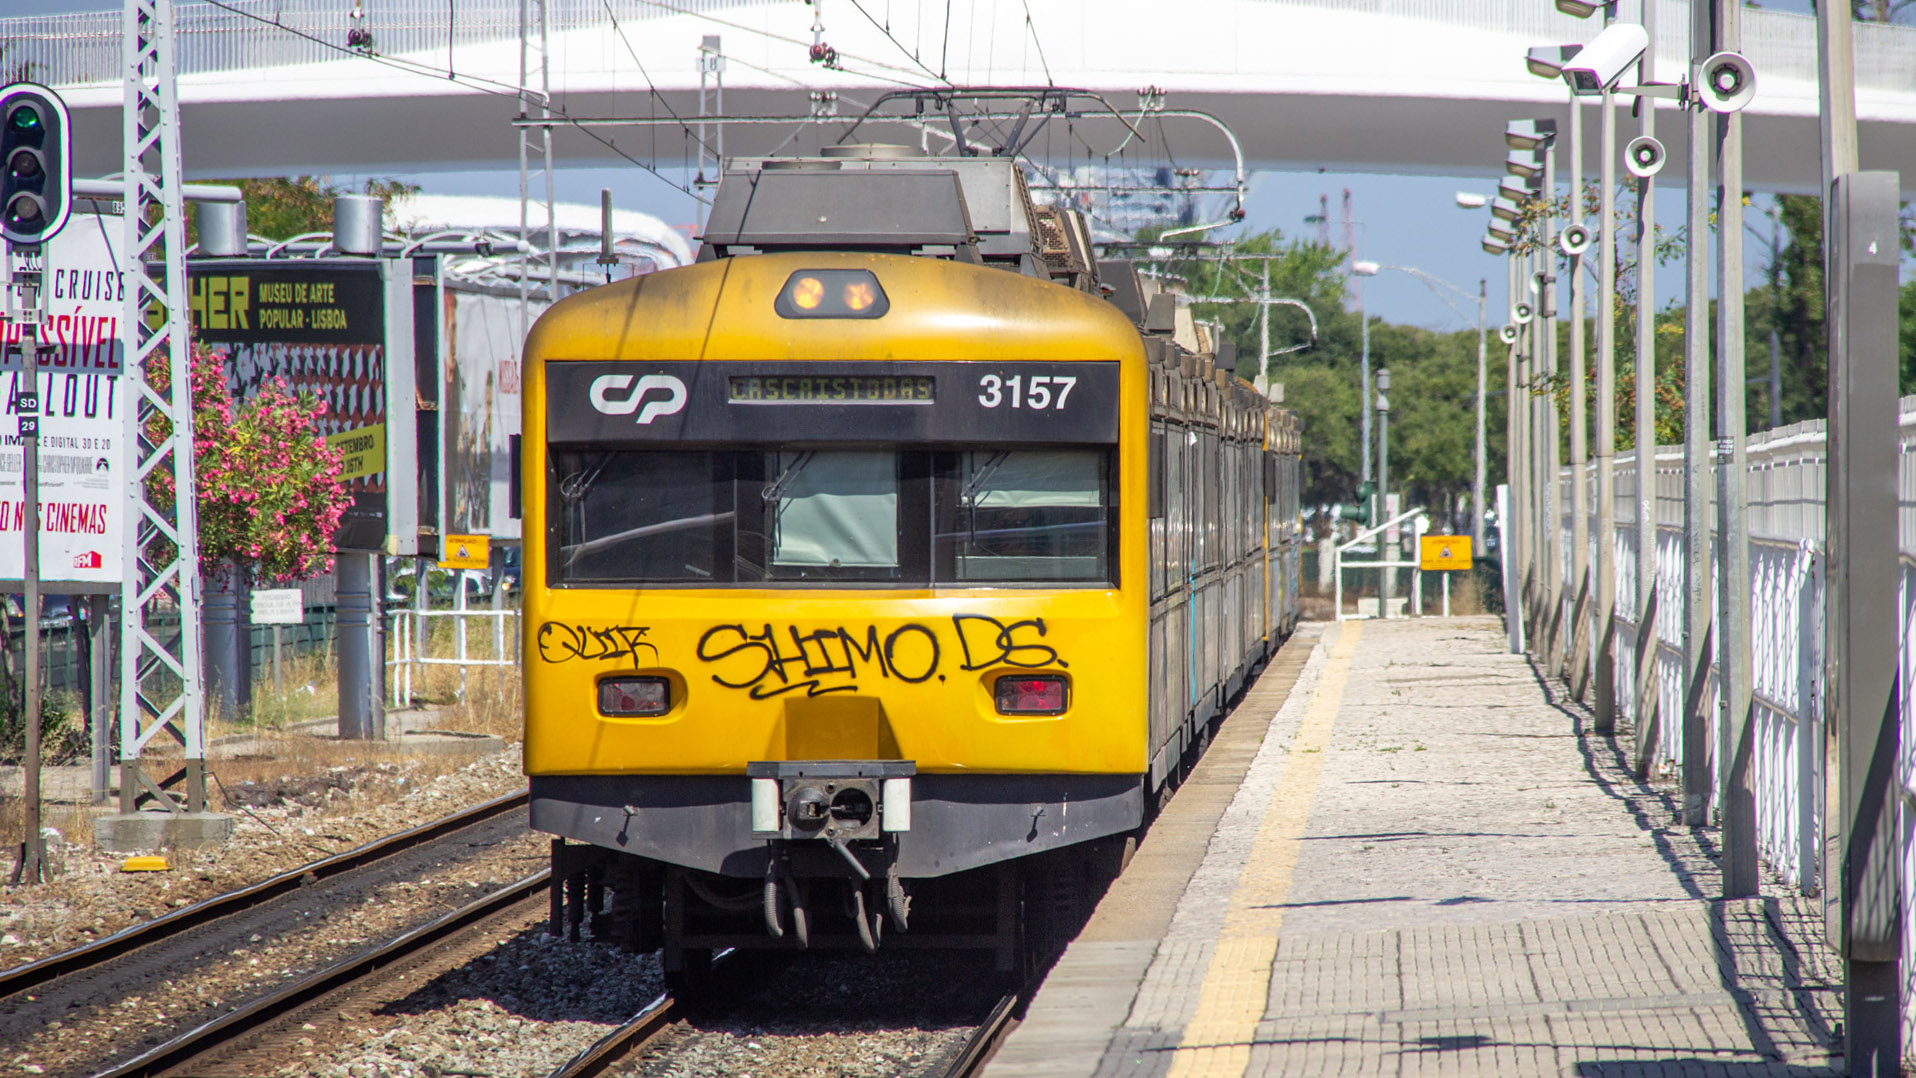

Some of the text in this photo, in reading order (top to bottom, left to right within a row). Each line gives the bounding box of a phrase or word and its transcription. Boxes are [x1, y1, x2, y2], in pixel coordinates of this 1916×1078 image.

[259, 283, 335, 303] MUSEU DE ARTE
[259, 309, 304, 329] POPULAR
[312, 309, 347, 329] LISBOA
[978, 375, 1076, 409] 3157
[20, 399, 37, 408] SD
[21, 422, 36, 431] 29
[43, 436, 48, 447] E
[51, 437, 79, 449] DIGITAL
[82, 438, 92, 450] 3D
[94, 438, 98, 450] E
[102, 439, 111, 450] 2D
[46, 502, 107, 534] CINEMAS
